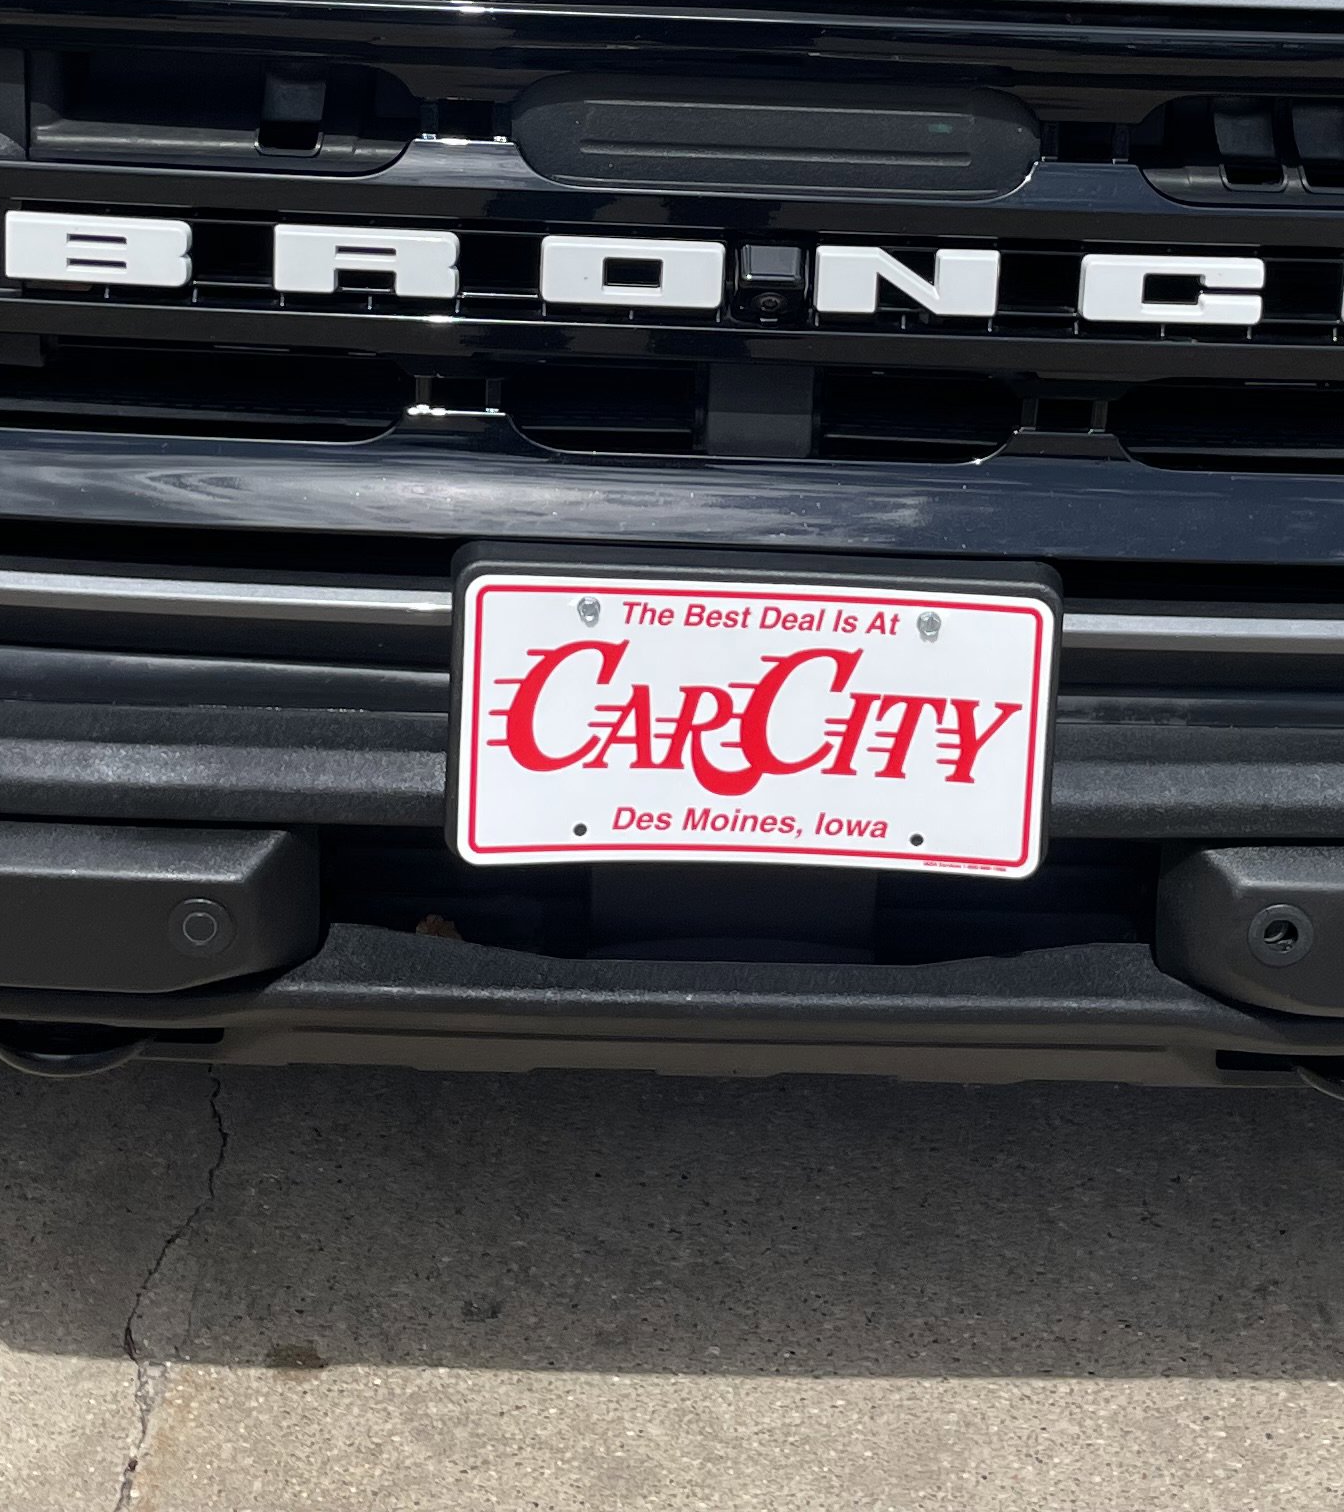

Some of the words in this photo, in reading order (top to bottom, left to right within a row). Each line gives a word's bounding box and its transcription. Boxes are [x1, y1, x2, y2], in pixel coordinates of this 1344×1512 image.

[621, 600, 675, 628] The
[683, 604, 751, 631] Best
[758, 606, 826, 633] Deal
[832, 610, 859, 634] Is
[866, 611, 901, 636] At
[612, 806, 672, 832] Des
[682, 808, 804, 839] Moines,
[814, 813, 889, 839] Iowa
